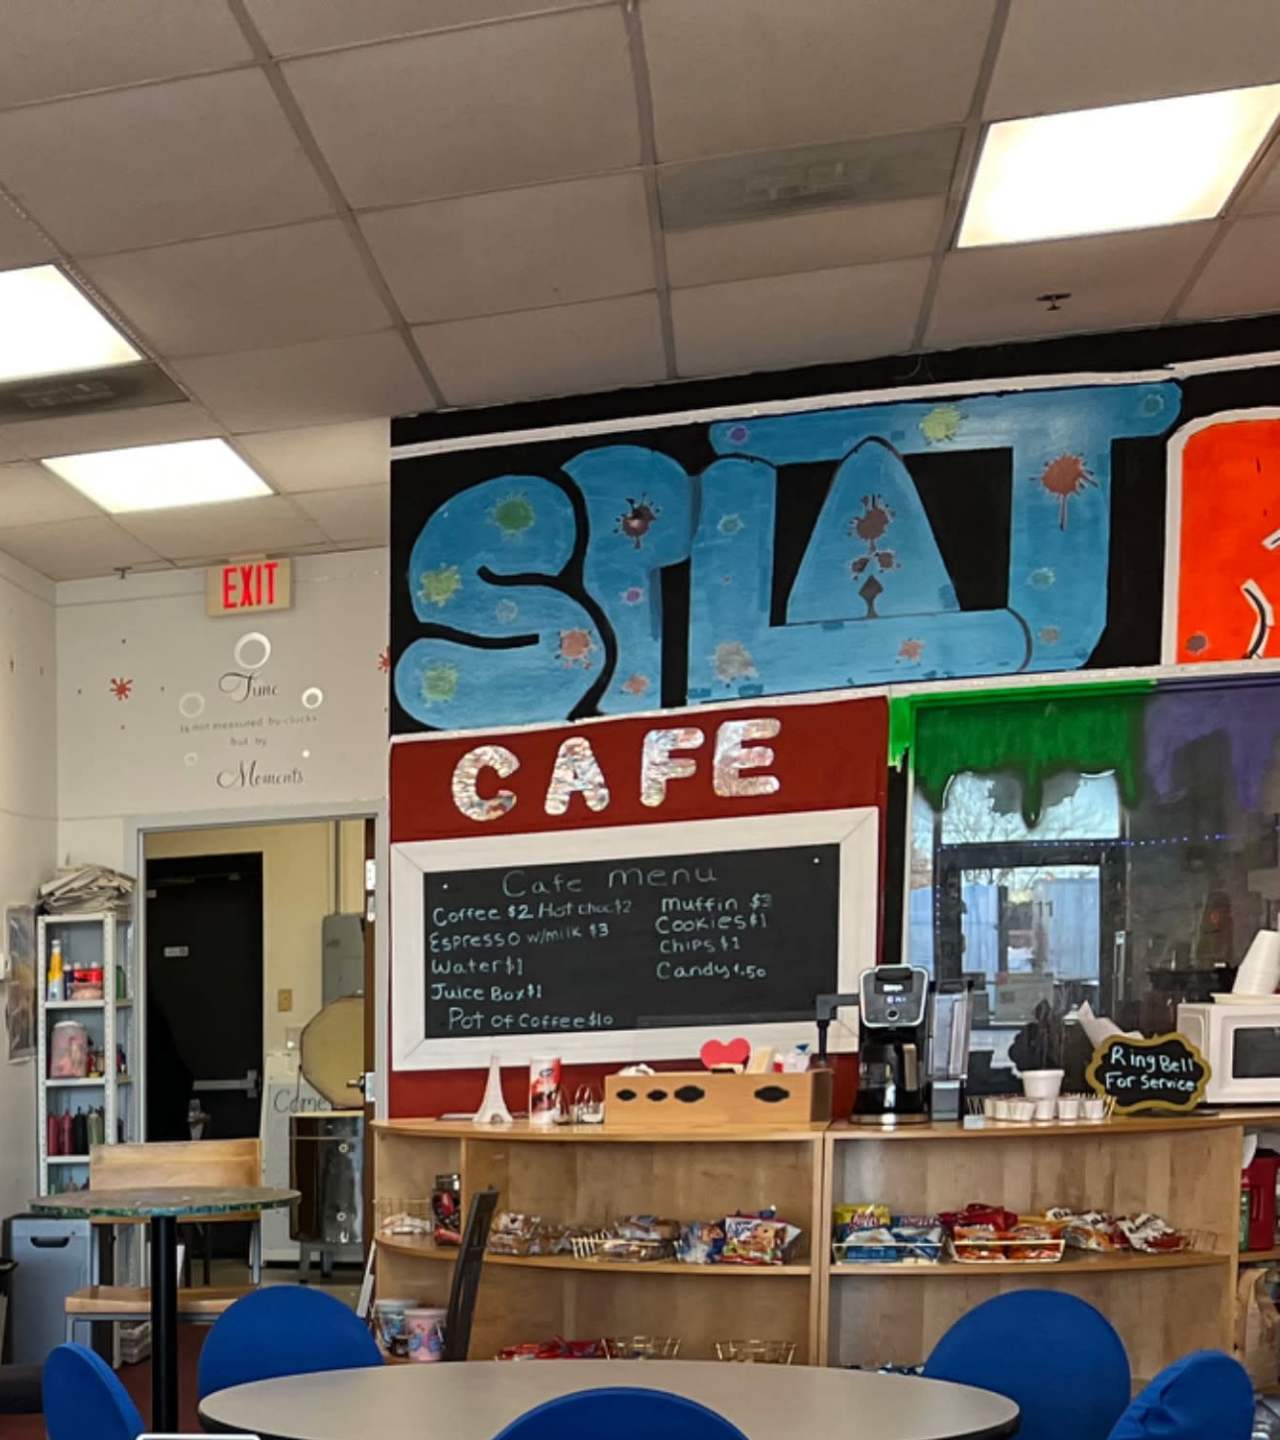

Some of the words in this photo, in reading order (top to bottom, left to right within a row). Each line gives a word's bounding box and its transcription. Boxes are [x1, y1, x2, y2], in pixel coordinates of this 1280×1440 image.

[222, 562, 279, 609] EXIT
[216, 760, 304, 788] Moments
[451, 718, 781, 822] CAFE
[503, 869, 583, 898] Cafe
[432, 907, 501, 926] Coffee
[507, 904, 534, 920] $2
[655, 914, 747, 934] Cookies
[429, 931, 521, 953] Espresso
[589, 923, 609, 938] $3
[656, 961, 730, 979] Candy
[431, 983, 485, 1001] Juice
[448, 1007, 485, 1030] Pot
[1111, 1046, 1155, 1073] Ring
[1159, 1055, 1195, 1073] Bell
[1105, 1072, 1136, 1090] For
